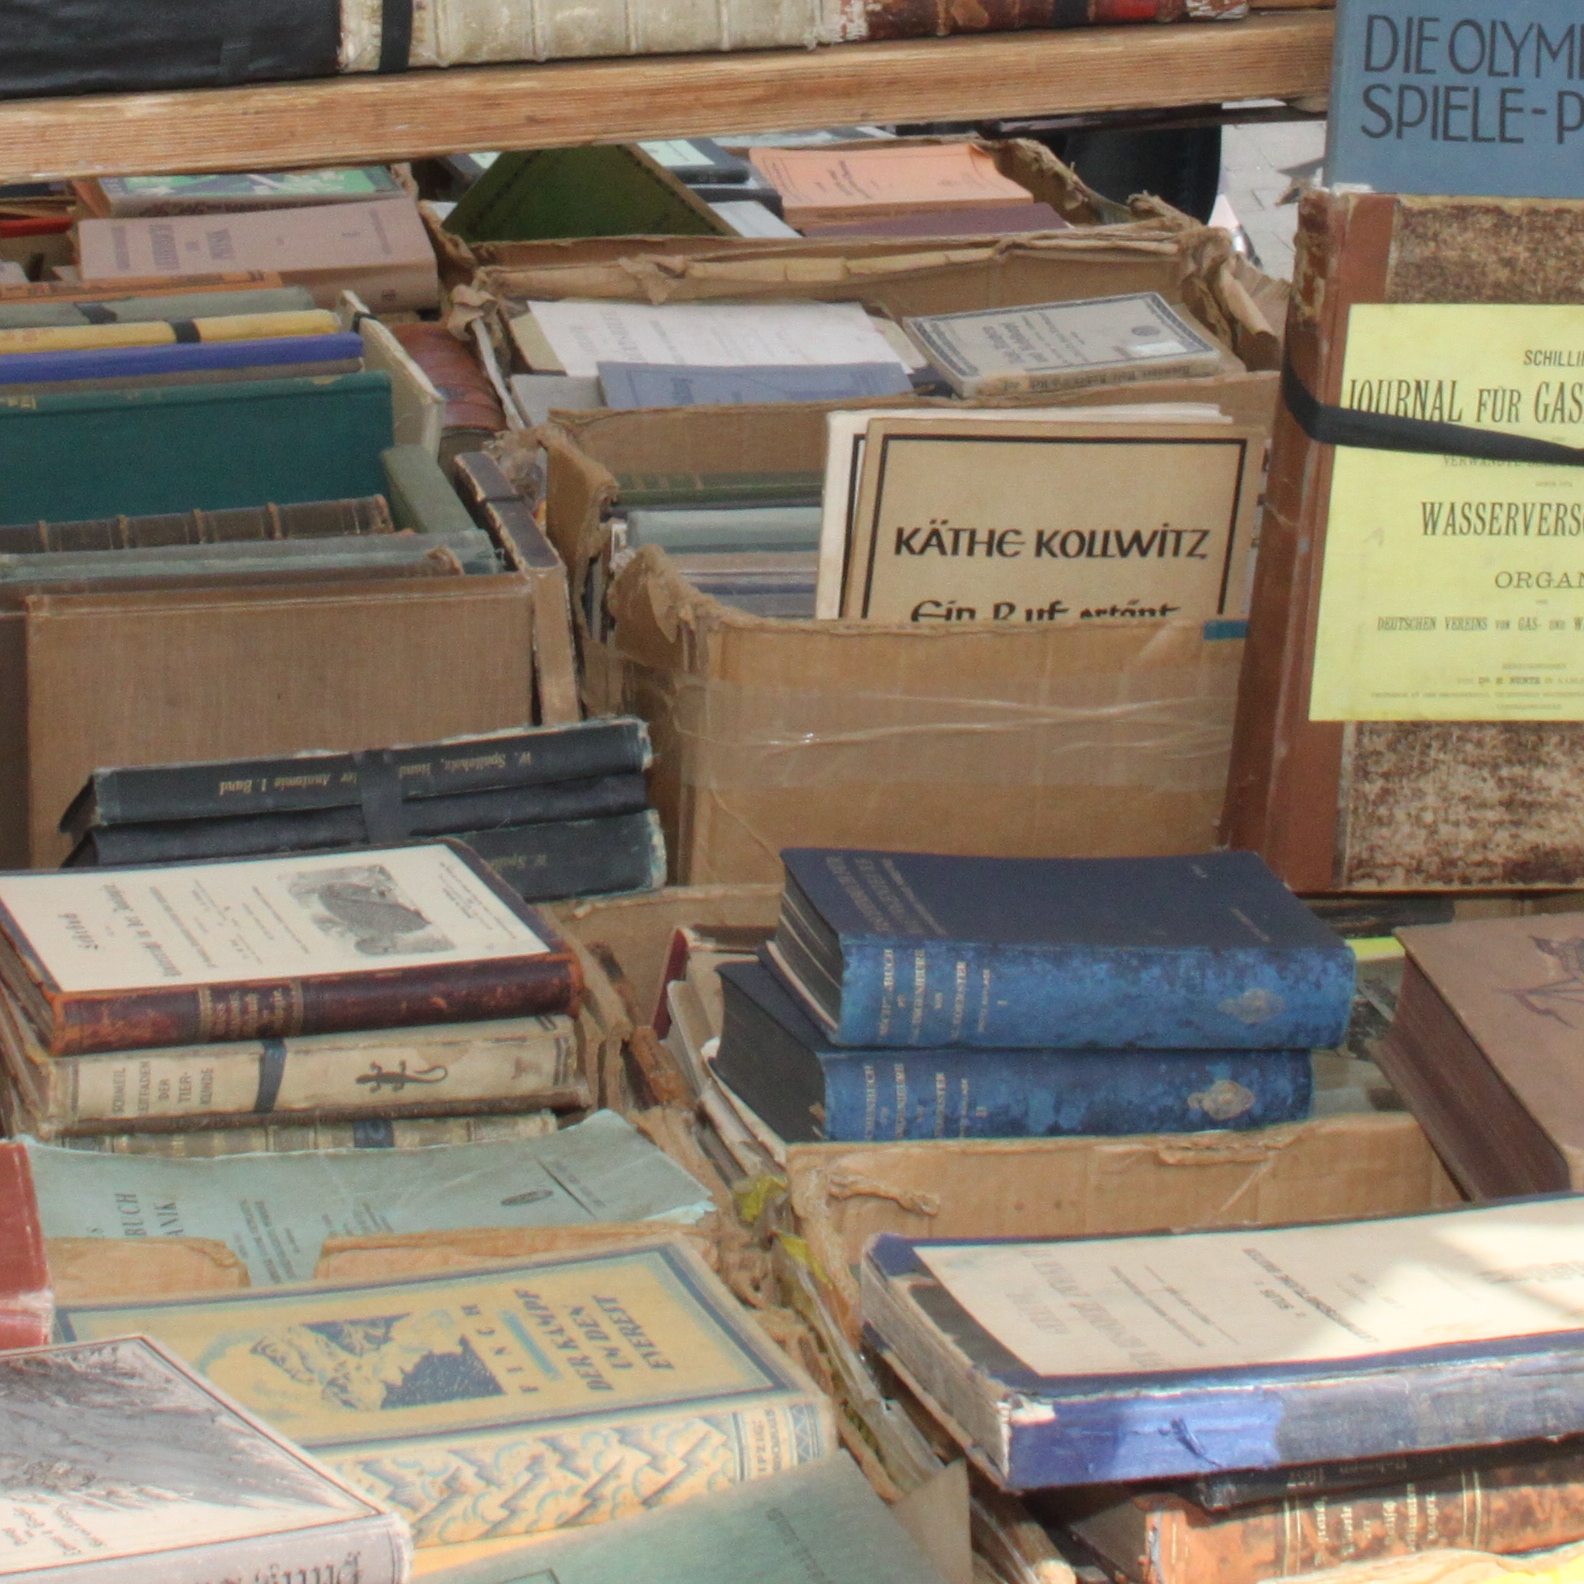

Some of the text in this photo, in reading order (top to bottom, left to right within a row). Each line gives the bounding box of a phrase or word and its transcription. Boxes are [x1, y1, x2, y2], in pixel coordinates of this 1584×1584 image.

[1364, 13, 1440, 74] DIE
[1476, 385, 1522, 425] FÜR
[893, 519, 1212, 562] KÄTHE KOLLWITZ
[1376, 615, 1437, 633] DEUTSCHEN
[1444, 616, 1489, 632] VEREINS
[157, 1078, 170, 1100] DER
[514, 1289, 617, 1392] DER KAMPF
[567, 1304, 612, 1348] DEN
[592, 1295, 677, 1373] EVEREST
